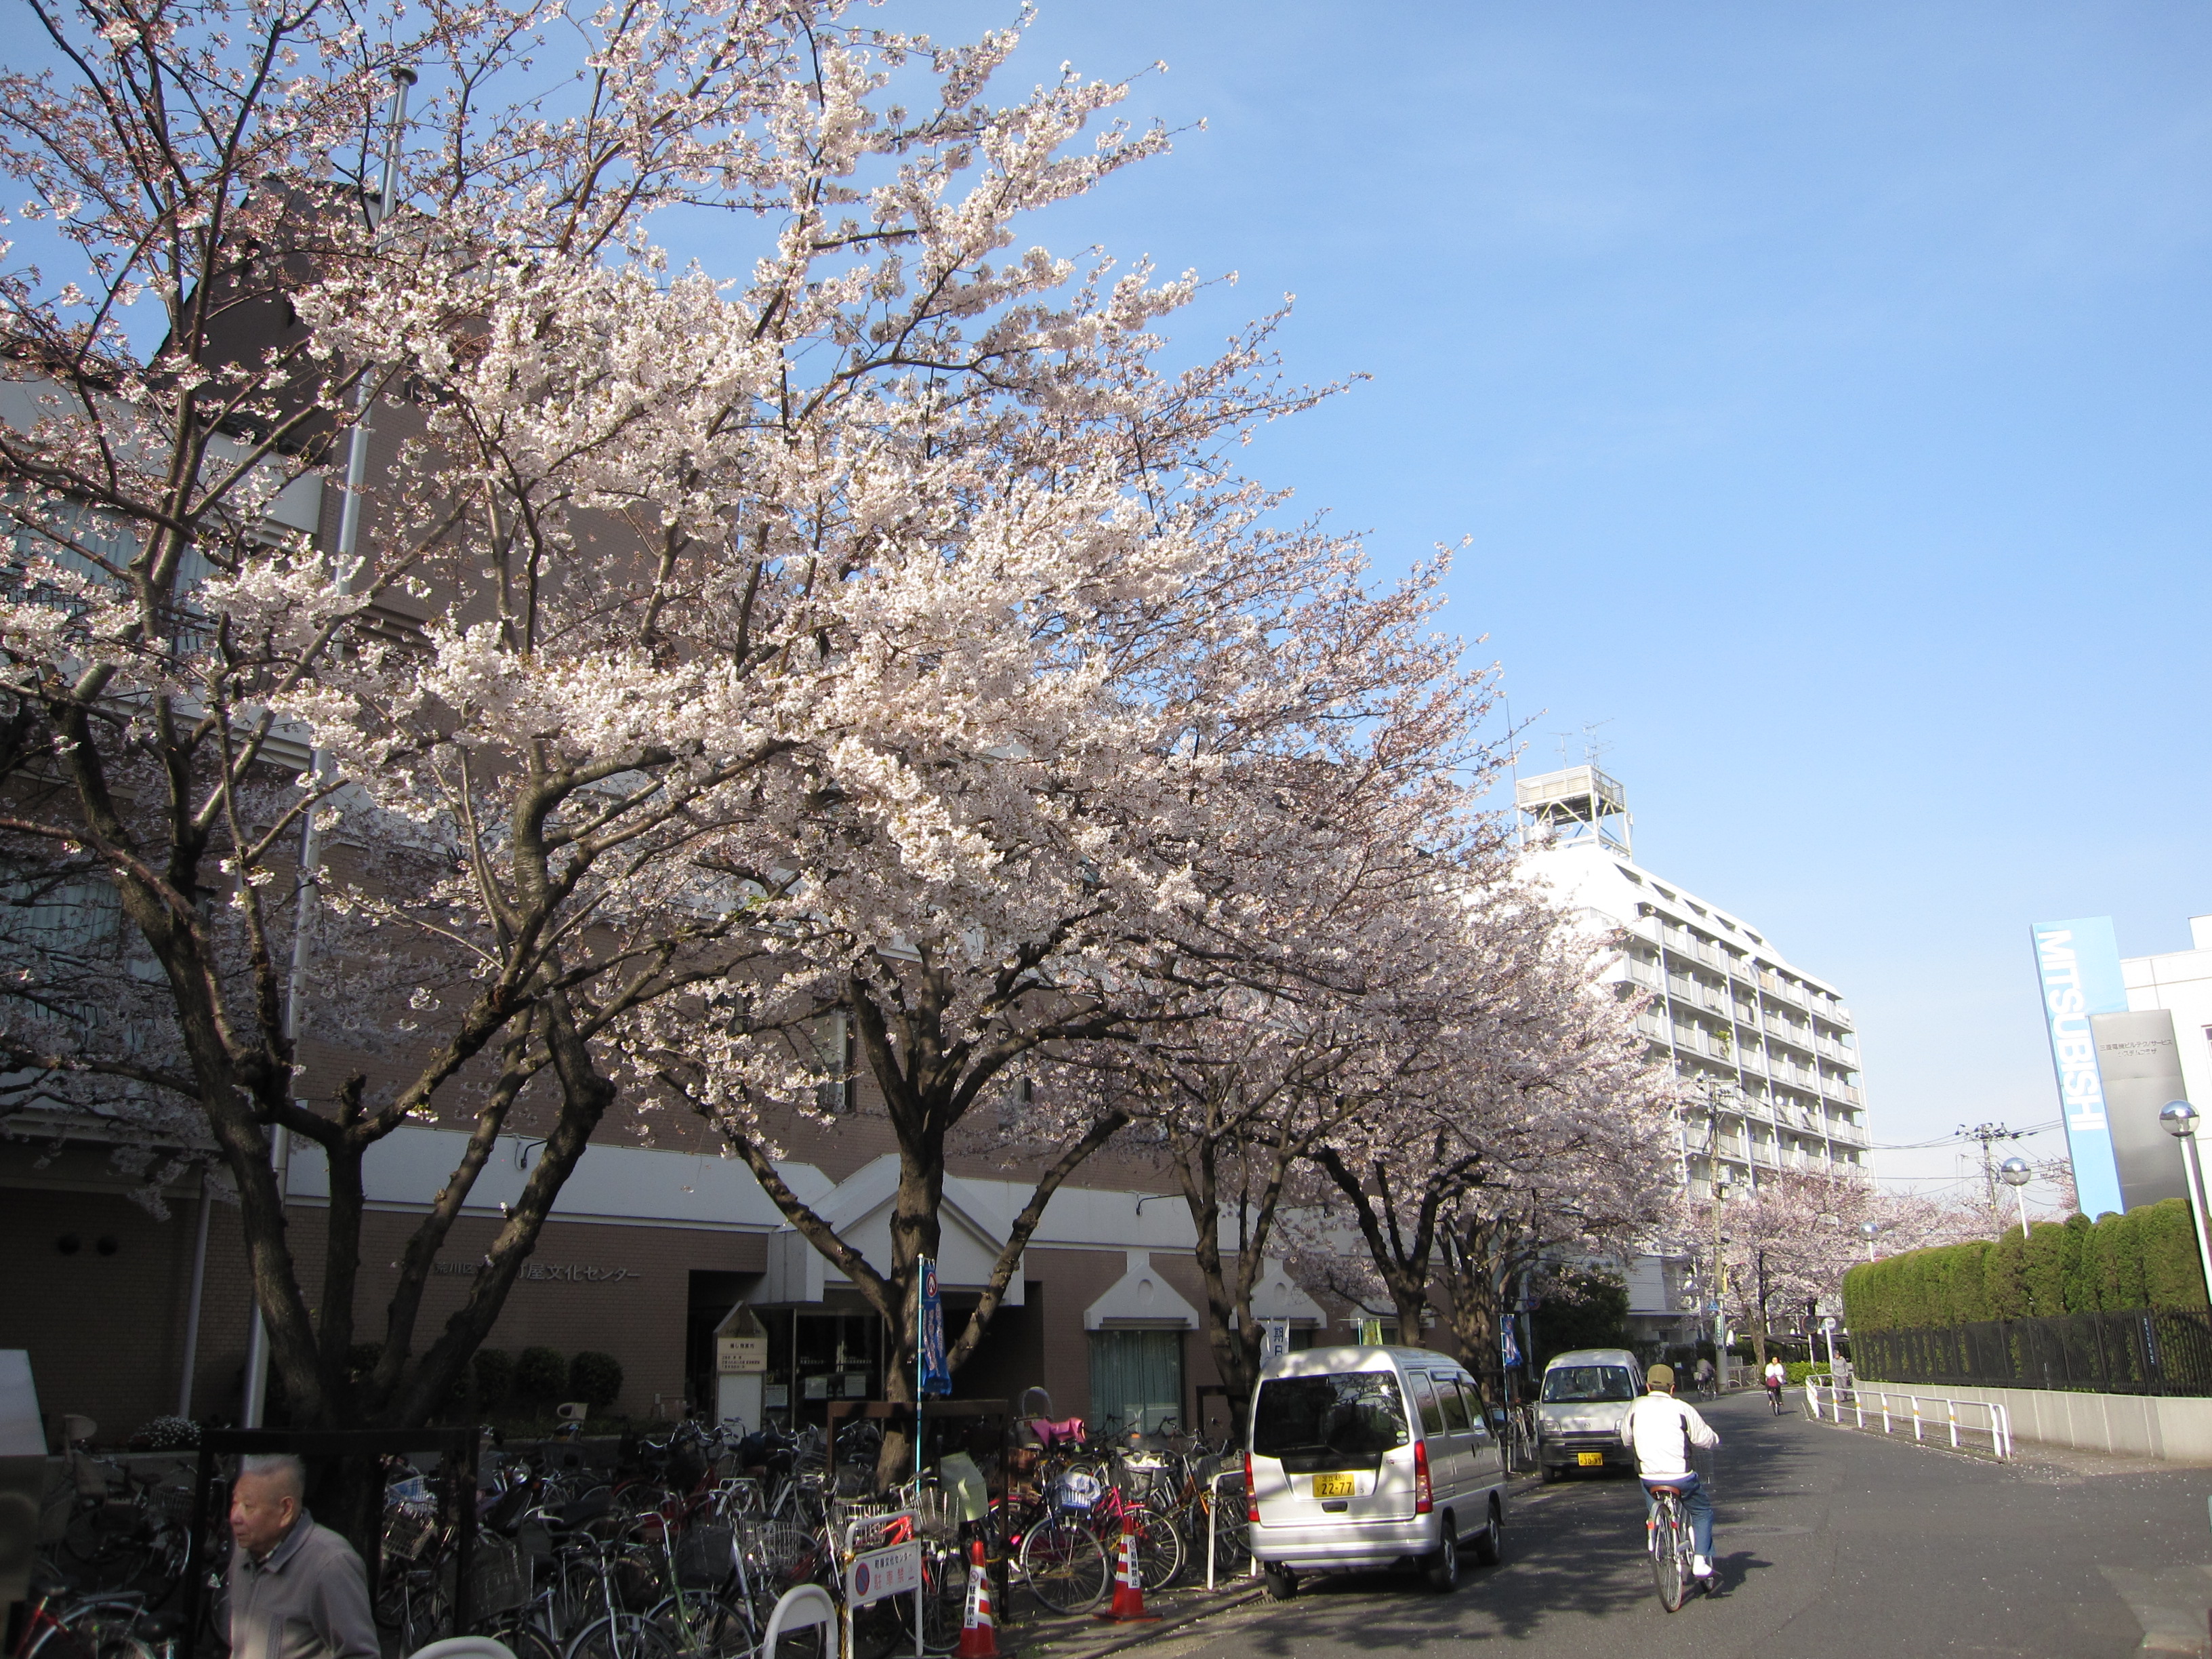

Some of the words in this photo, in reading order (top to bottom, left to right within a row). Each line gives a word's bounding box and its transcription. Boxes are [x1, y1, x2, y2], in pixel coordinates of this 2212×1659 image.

[2037, 930, 2106, 1131] MITSUBISHI
[435, 1263, 484, 1274] 荒川区
[1322, 1481, 1352, 1495] 22-77
[874, 1565, 915, 1590] 駐車禁止
